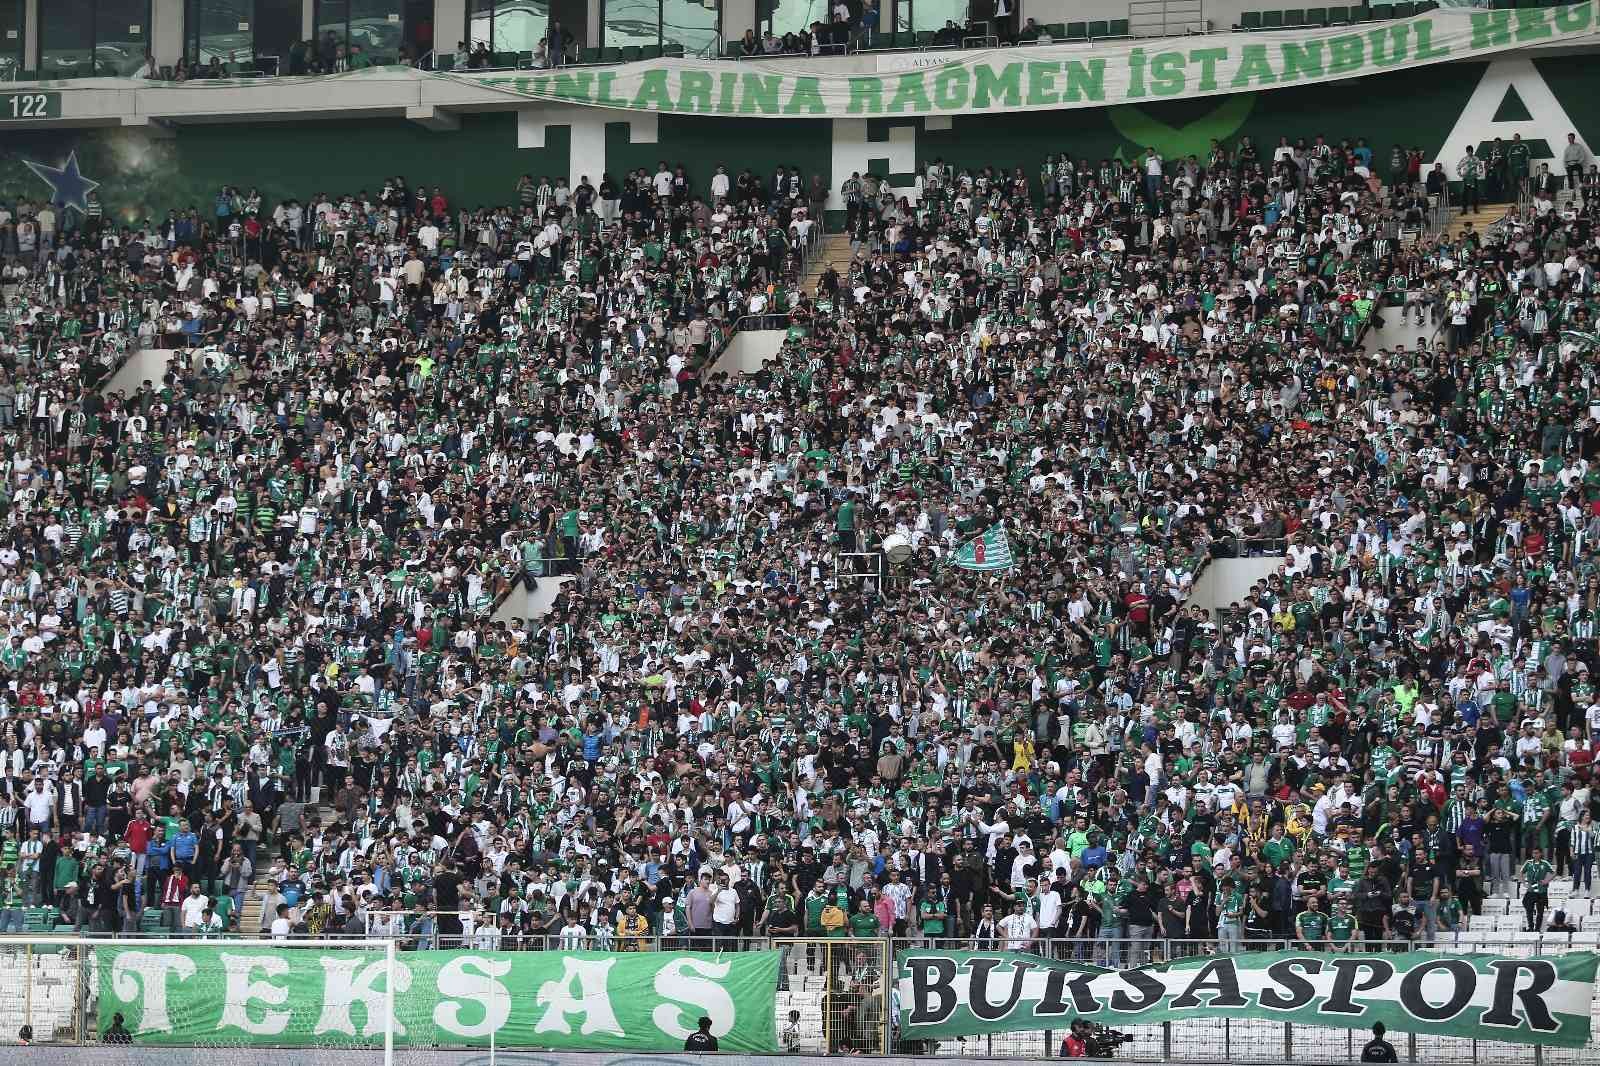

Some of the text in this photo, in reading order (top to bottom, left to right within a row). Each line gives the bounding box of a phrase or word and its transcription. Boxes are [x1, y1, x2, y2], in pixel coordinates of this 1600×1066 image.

[8, 94, 48, 118] 122
[112, 951, 736, 1041] TEKSAS
[903, 956, 1564, 1034] BURSASPOR
